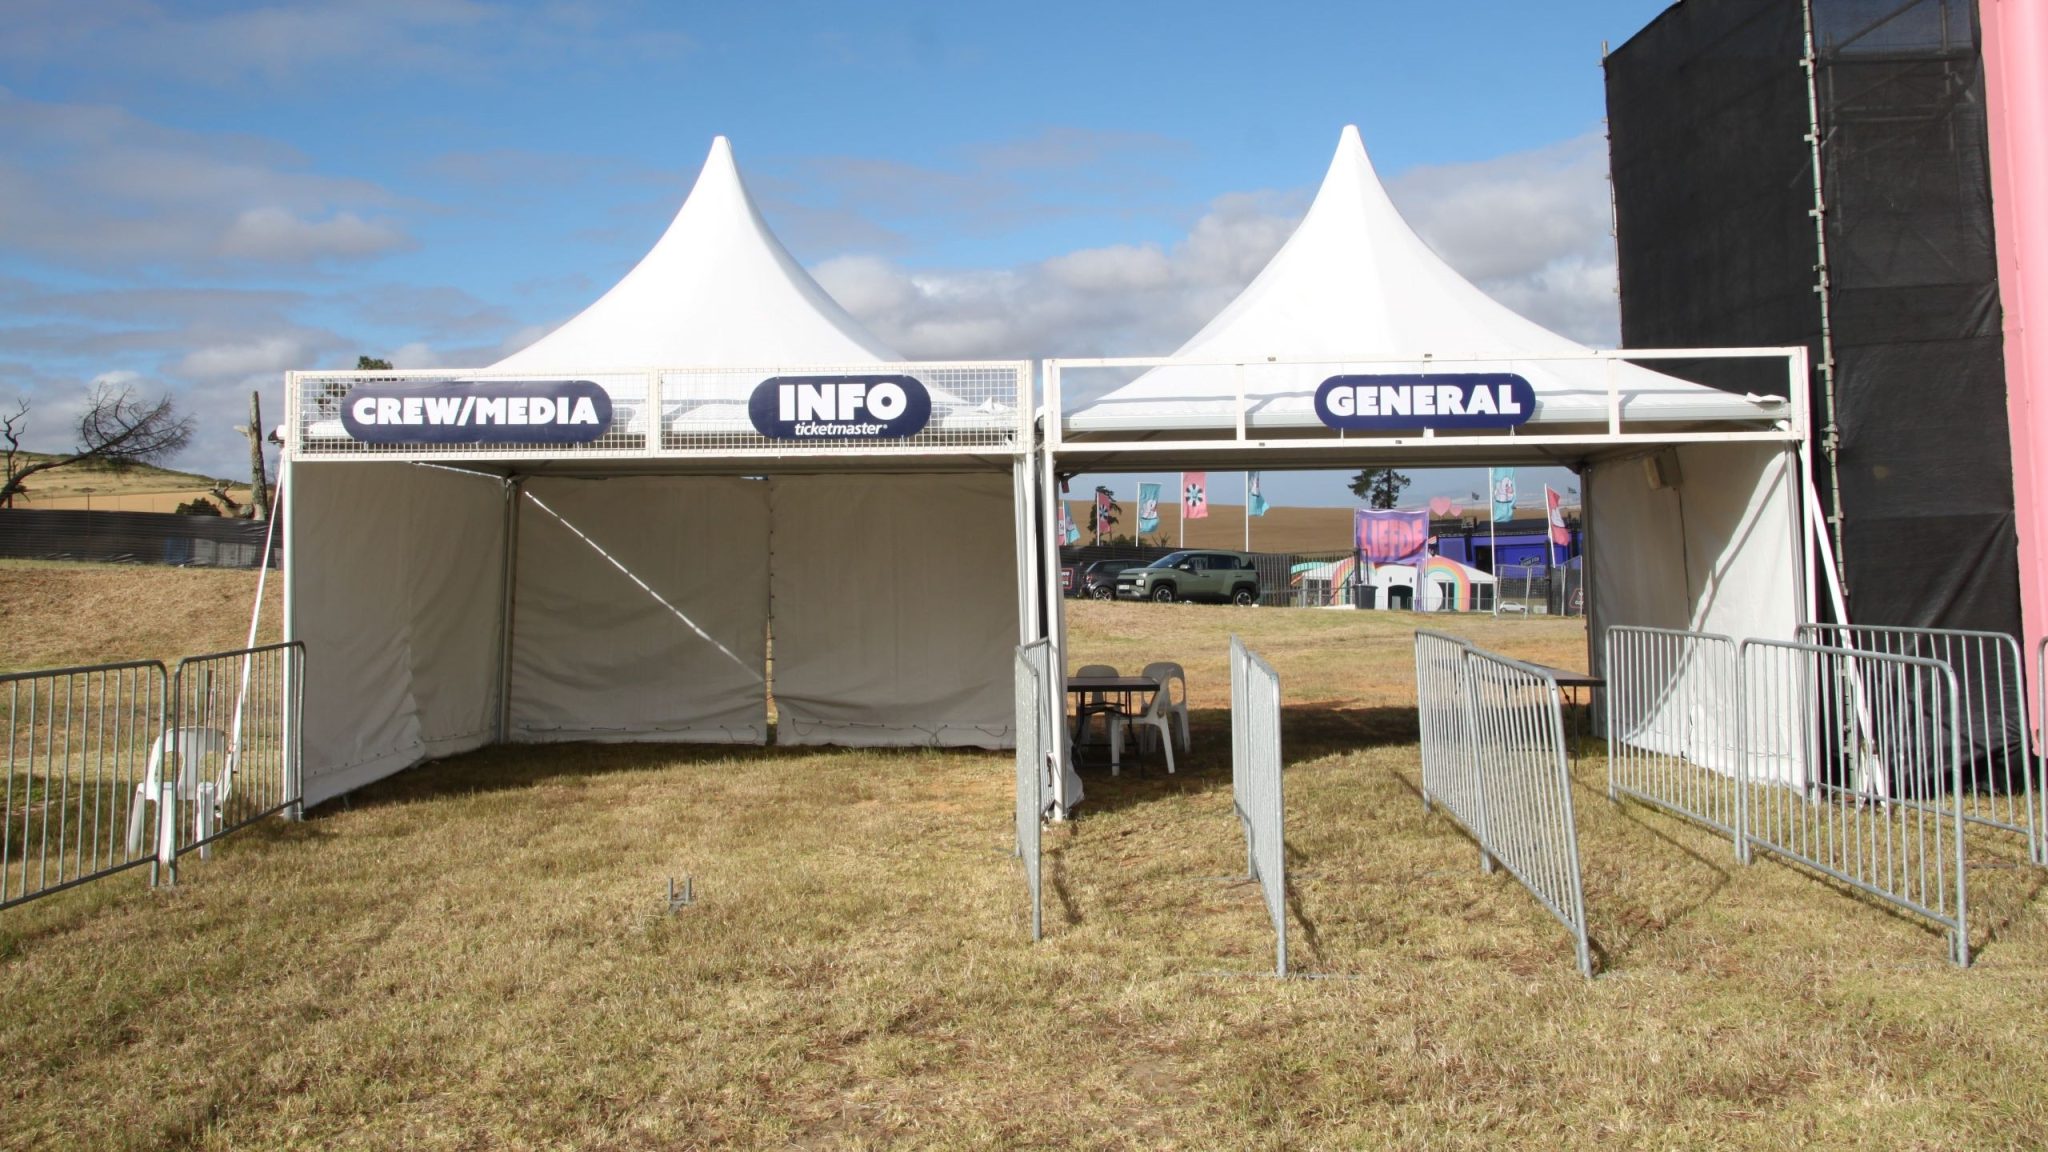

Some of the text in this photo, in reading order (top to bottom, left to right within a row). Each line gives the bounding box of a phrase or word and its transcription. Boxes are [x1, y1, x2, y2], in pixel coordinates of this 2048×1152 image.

[352, 396, 600, 427] CREW/MEDIA
[779, 382, 907, 421] INFO
[1326, 384, 1521, 416] GENERAL
[794, 422, 883, 436] ticketmaster
